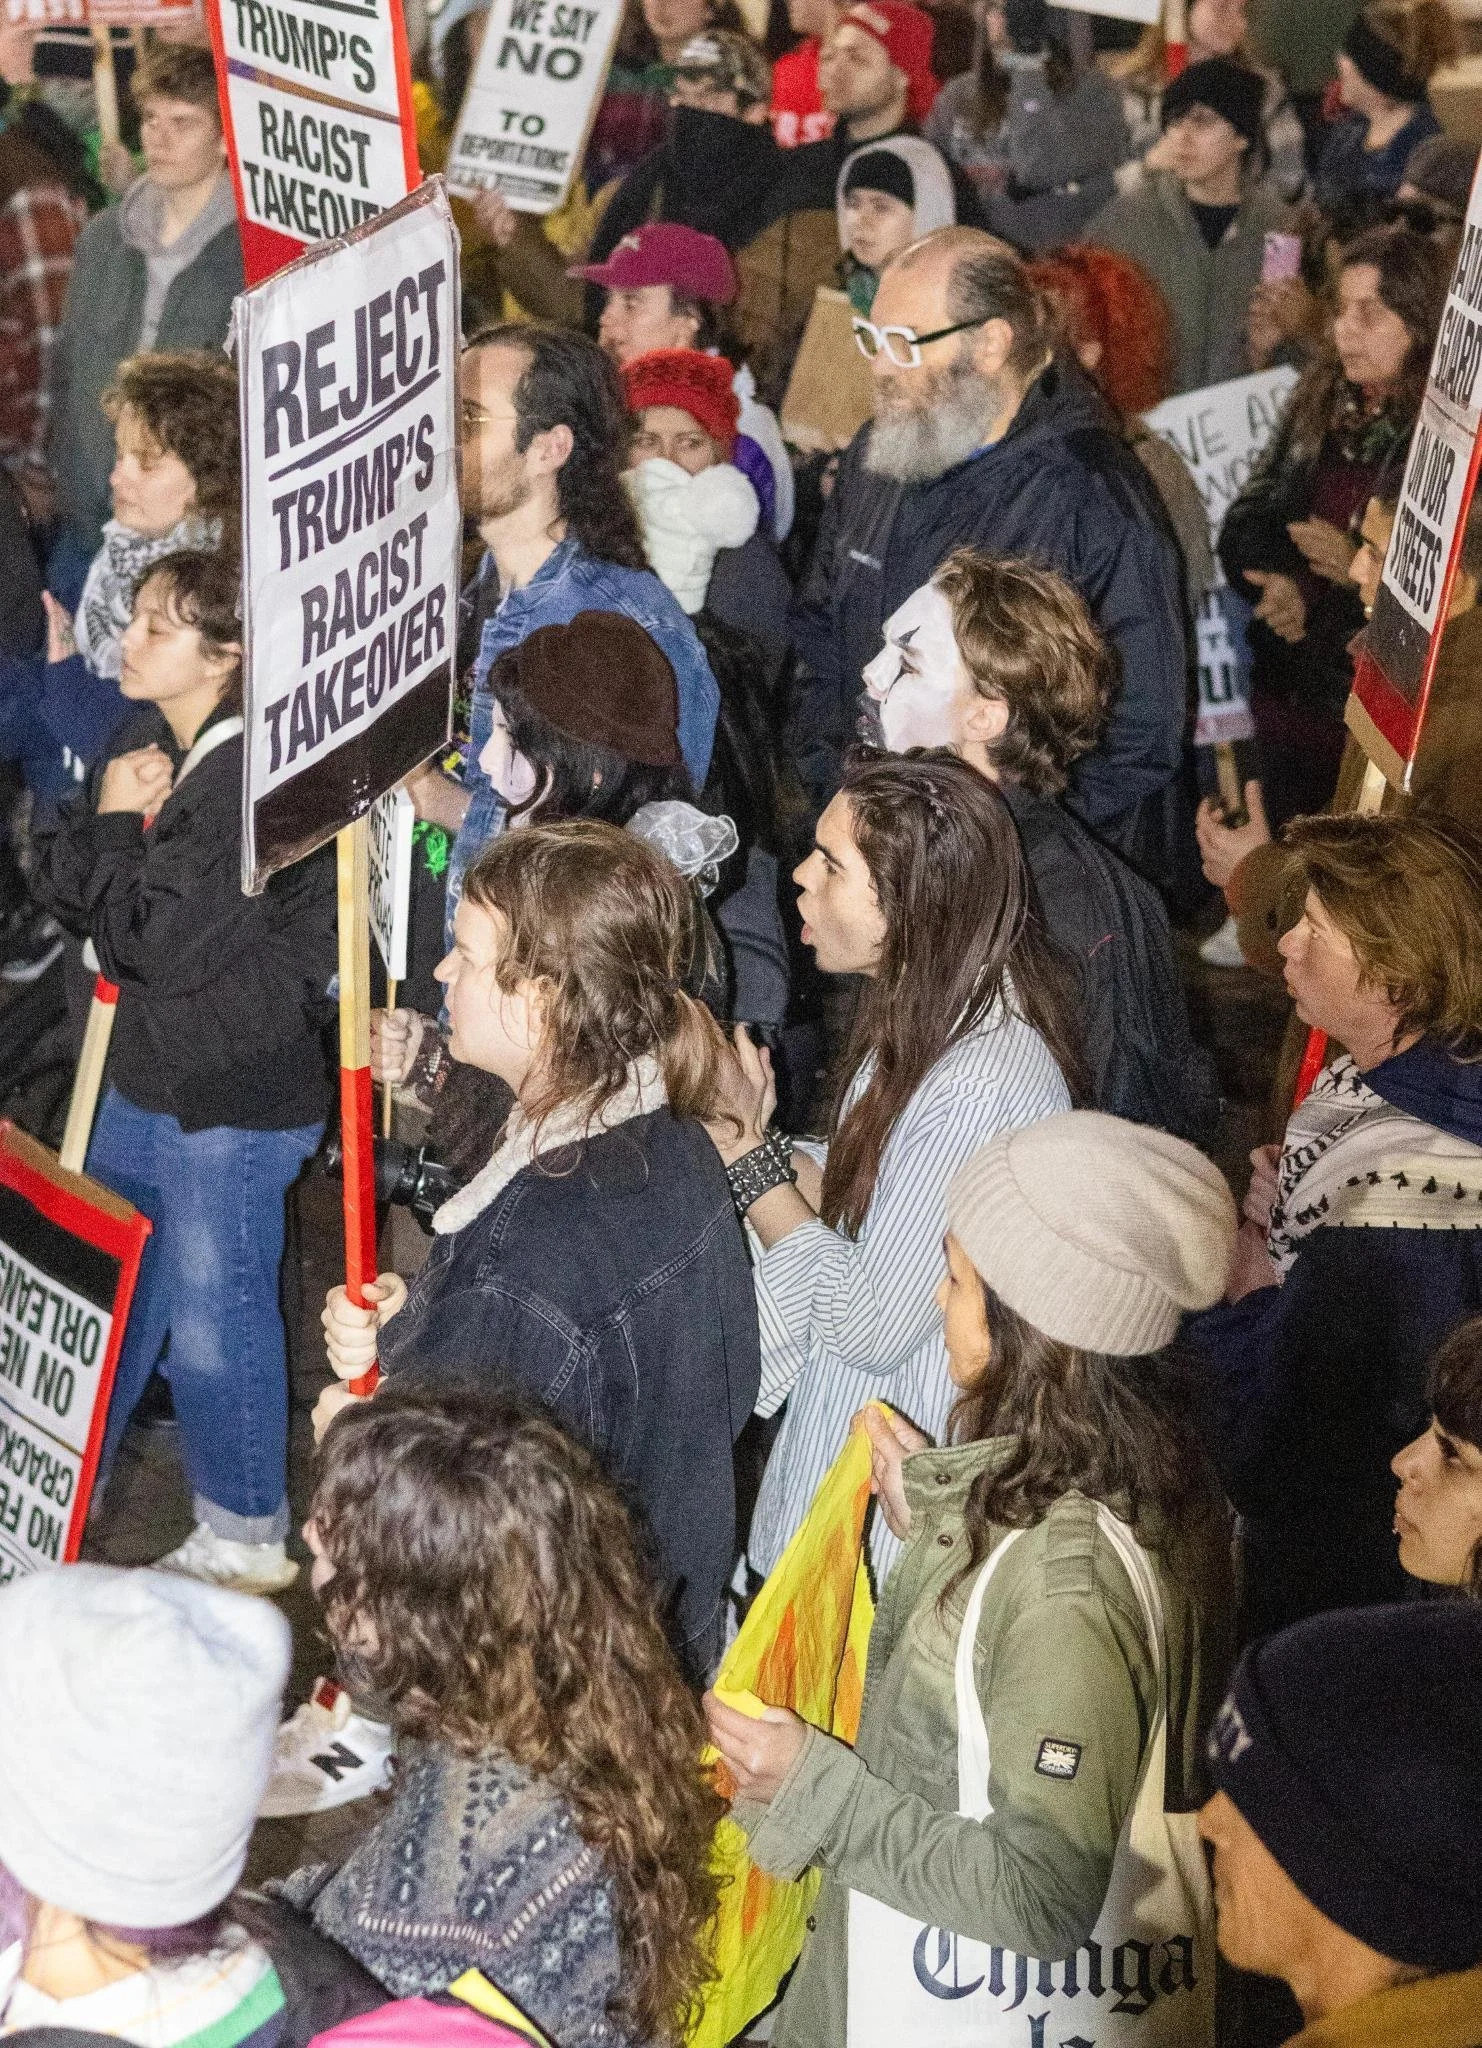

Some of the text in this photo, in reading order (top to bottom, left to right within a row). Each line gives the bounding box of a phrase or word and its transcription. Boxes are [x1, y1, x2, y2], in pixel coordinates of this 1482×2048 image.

[230, 0, 377, 94] TRUMP'S
[495, 36, 584, 82] NO
[550, 3, 600, 43] SAY
[258, 100, 372, 189] RACIST
[501, 109, 546, 137] TO
[261, 259, 446, 459] REJECT
[272, 413, 435, 572] TRUMP'S
[1420, 434, 1456, 527] OUR
[300, 511, 429, 668] RACIST
[1389, 500, 1443, 615] STREETS
[263, 582, 447, 774] TAKEOVER
[0, 1324, 75, 1417] ON NE
[0, 1420, 74, 1508] CRACK
[26, 1503, 64, 1562] NO
